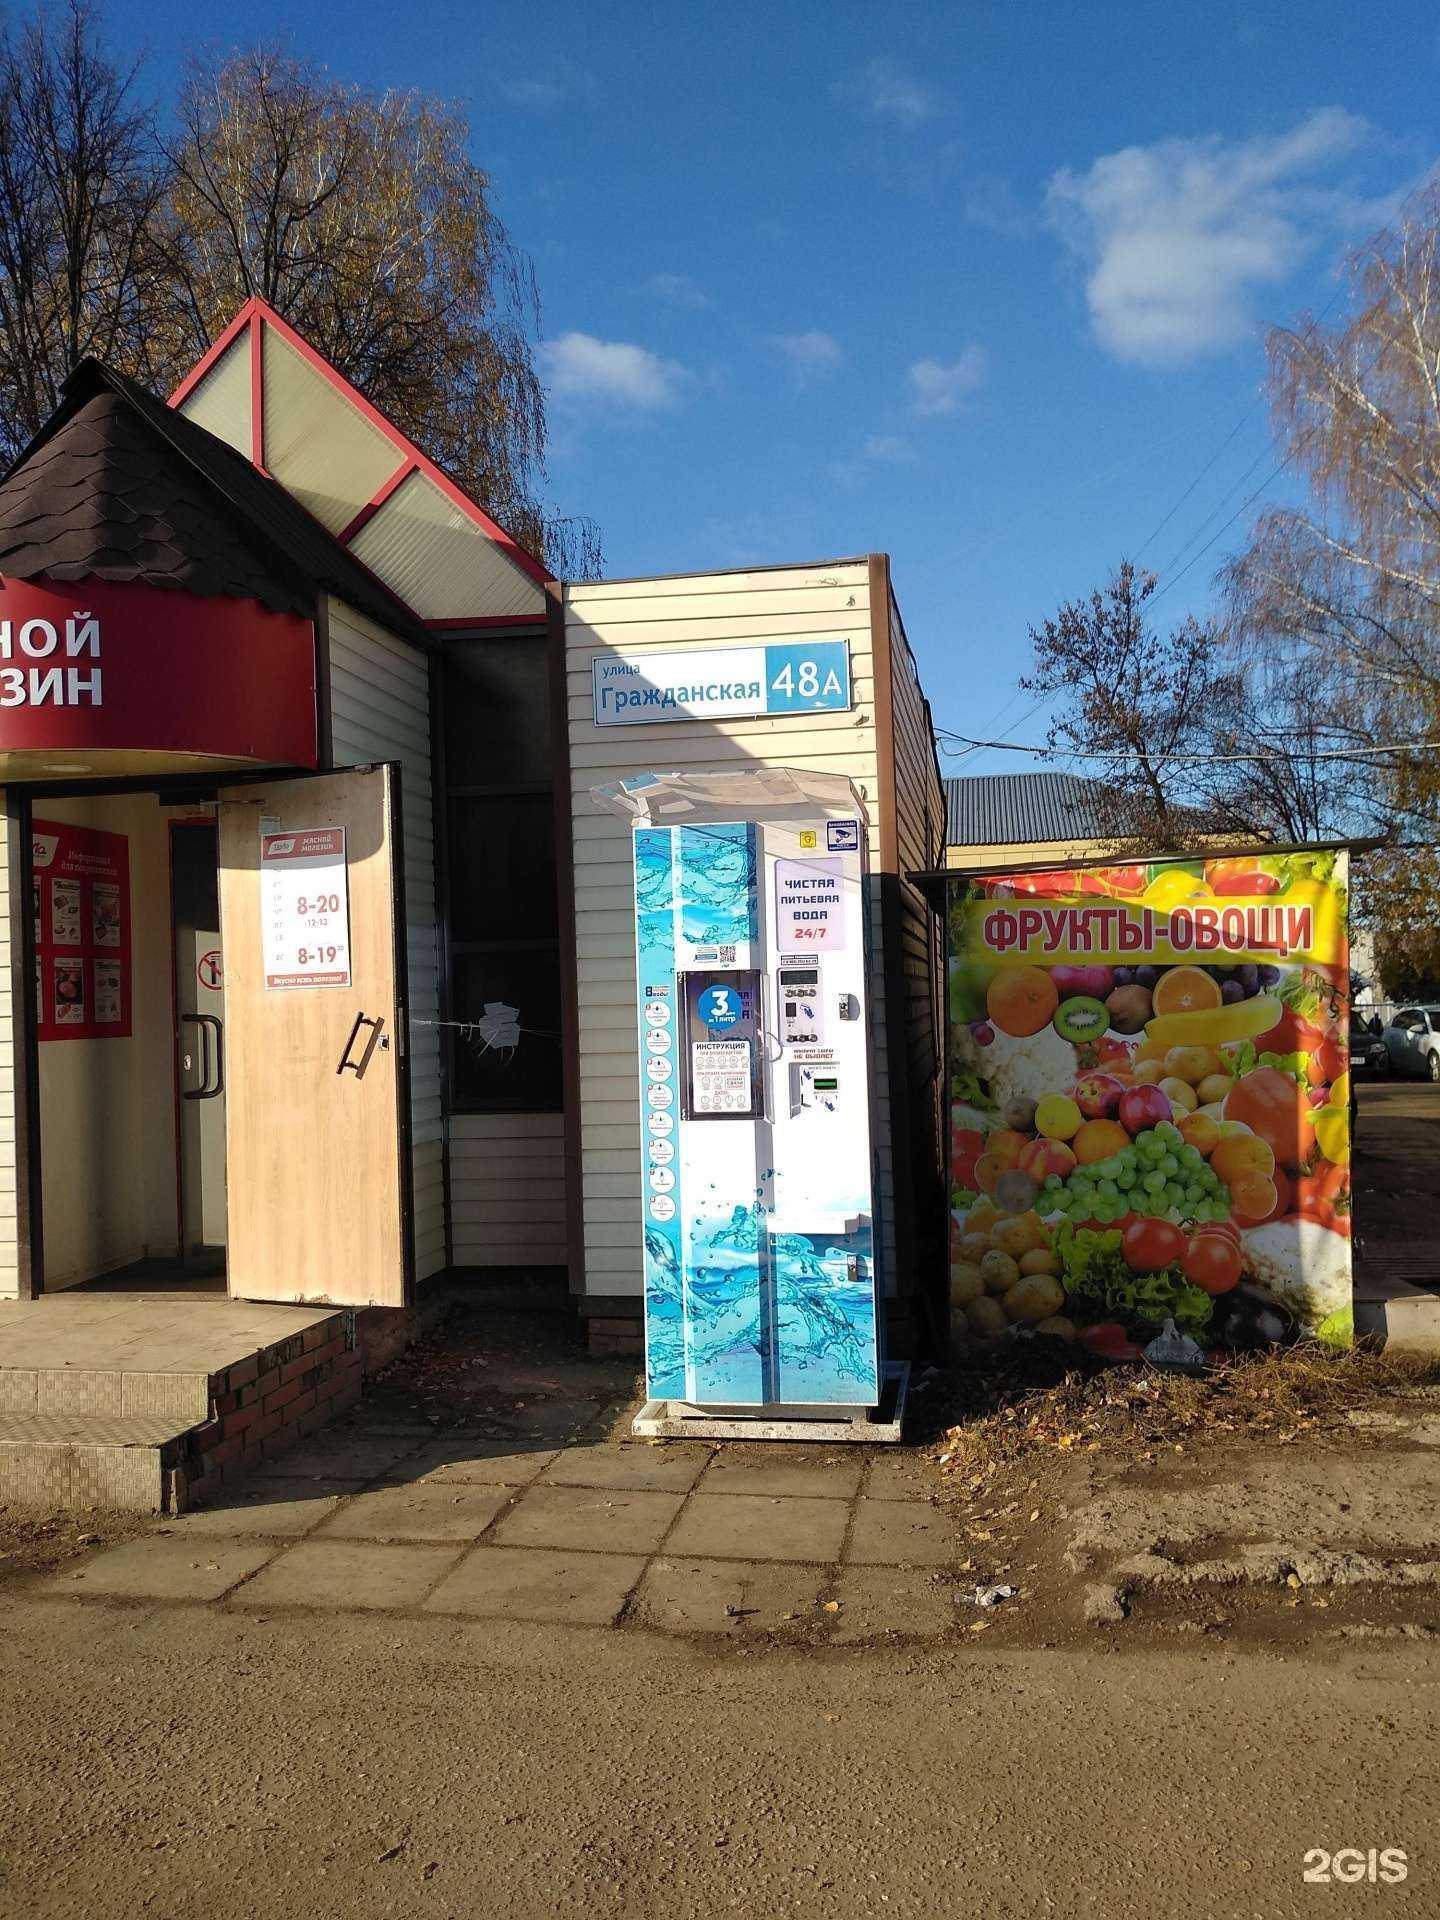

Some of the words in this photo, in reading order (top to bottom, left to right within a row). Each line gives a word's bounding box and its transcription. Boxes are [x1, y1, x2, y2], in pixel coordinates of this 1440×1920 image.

[603, 664, 640, 679] улица
[0, 668, 102, 706] ЗИН
[601, 681, 760, 712] Гражданская
[785, 879, 835, 889] ЧИСТАЯ
[297, 894, 340, 915] 8-20
[781, 895, 840, 904] ПИТЬЕВАЯ
[793, 911, 828, 920] ВОДА
[795, 928, 827, 940] 24/7
[984, 907, 1313, 957] ФРУКТЫ-ОВОЩИ
[710, 990, 729, 1017] 3
[696, 1042, 746, 1051] ИНСТРУКЦИЯ
